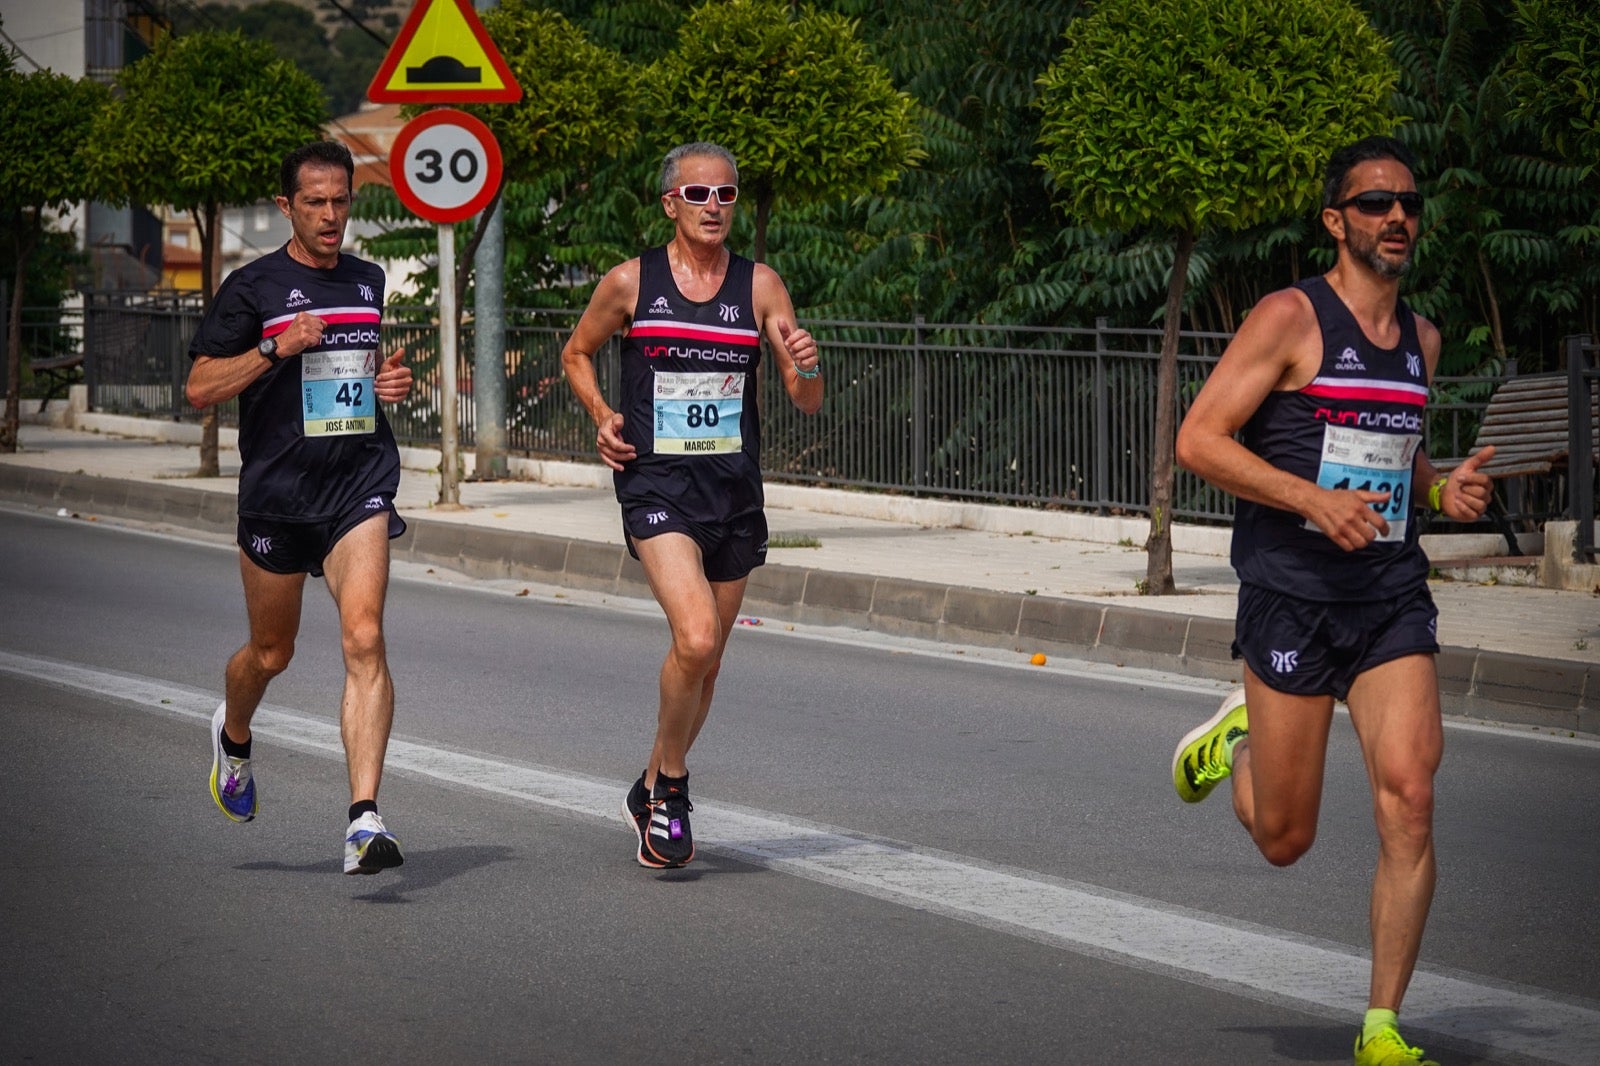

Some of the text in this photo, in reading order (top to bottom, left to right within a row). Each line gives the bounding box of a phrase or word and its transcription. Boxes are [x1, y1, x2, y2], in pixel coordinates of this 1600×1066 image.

[415, 149, 478, 184] 30
[648, 307, 674, 315] austral
[335, 382, 363, 407] 42
[687, 404, 720, 428] 80
[325, 420, 344, 433] JOSÉ
[684, 440, 716, 451] MARCOS
